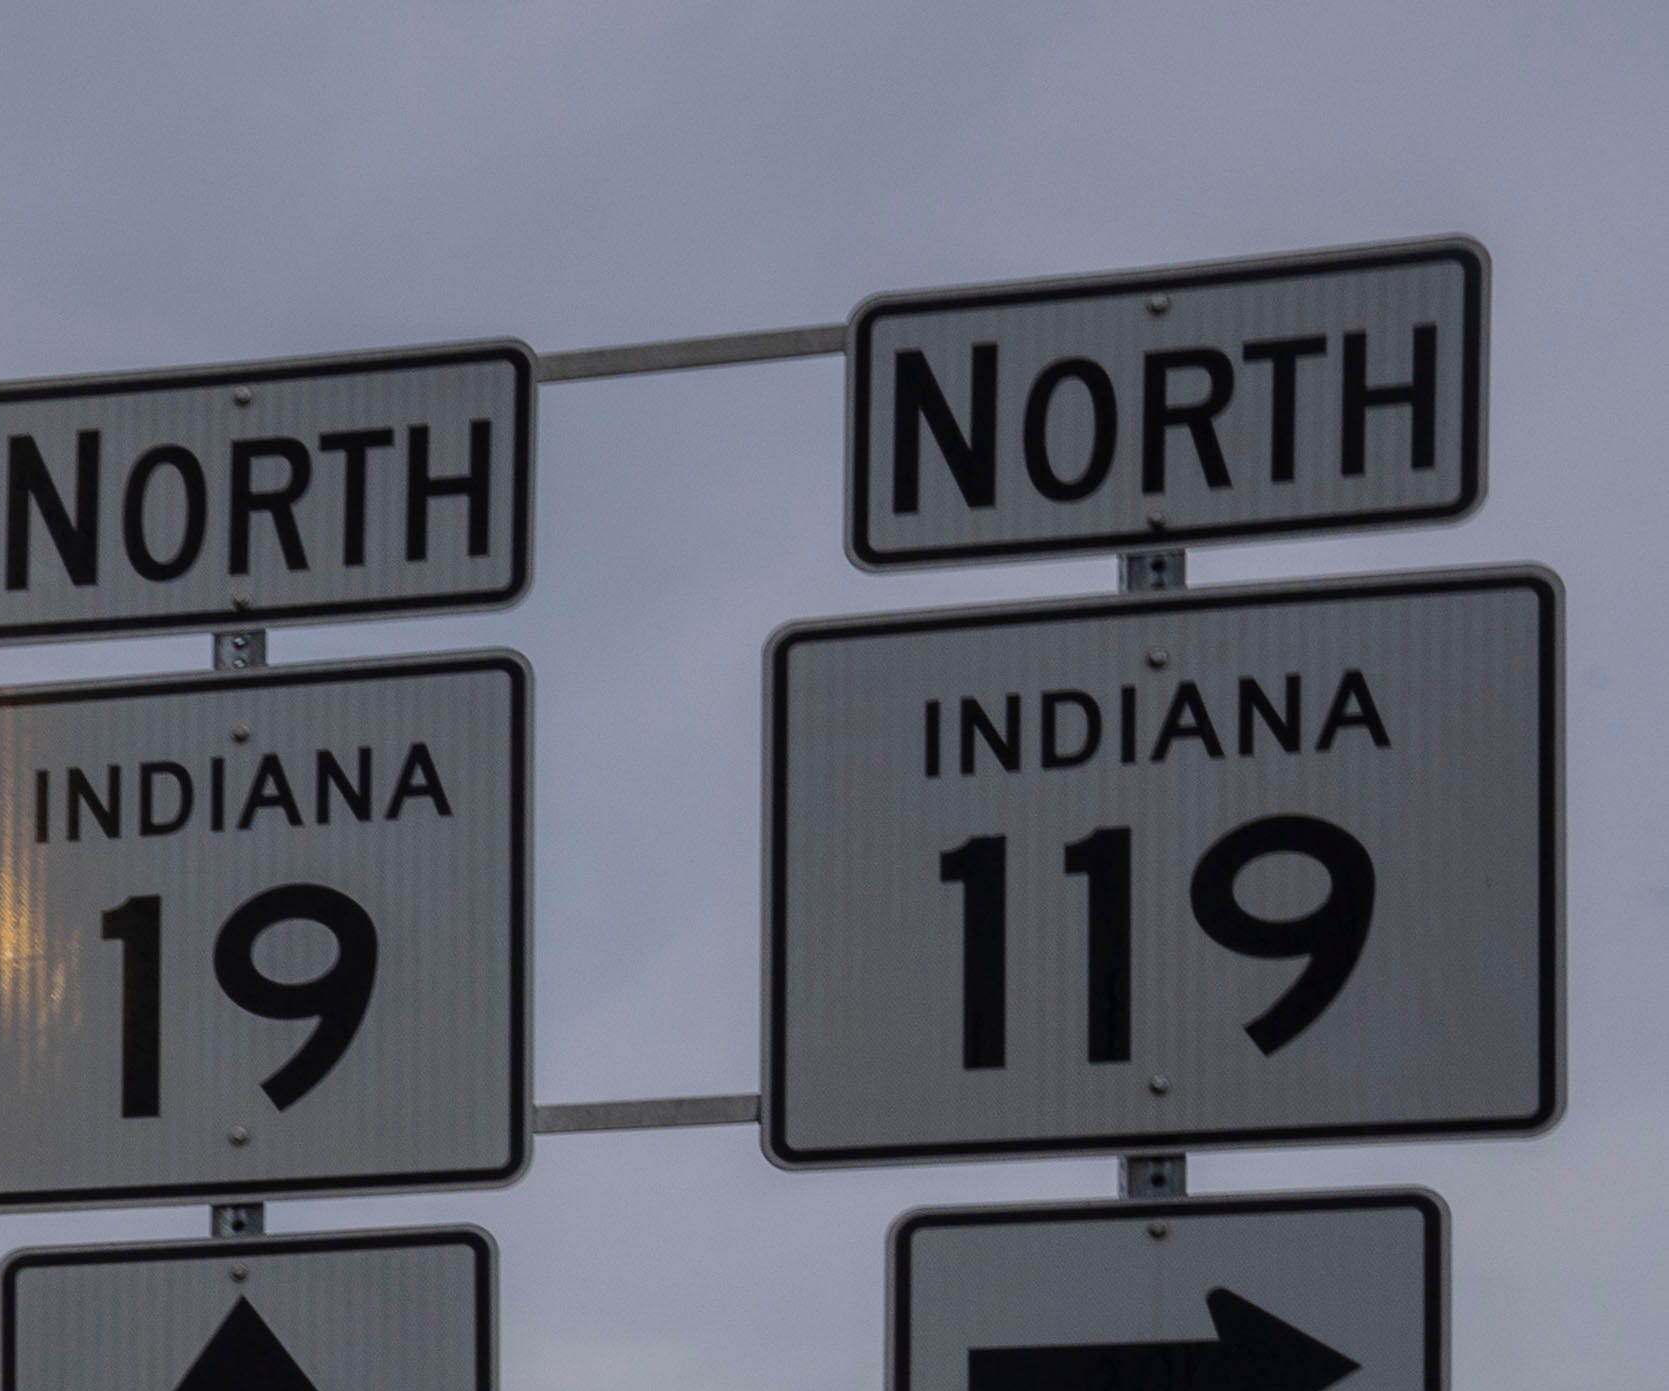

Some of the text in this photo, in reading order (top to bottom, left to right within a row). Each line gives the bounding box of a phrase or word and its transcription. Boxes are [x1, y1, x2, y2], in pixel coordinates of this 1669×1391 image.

[5, 418, 492, 591] NORTH
[892, 324, 1439, 514] NORTH
[33, 742, 453, 844] INDIANA
[924, 669, 1391, 778] INDIANA
[100, 882, 378, 1119] 19
[939, 812, 1376, 1072] 119
